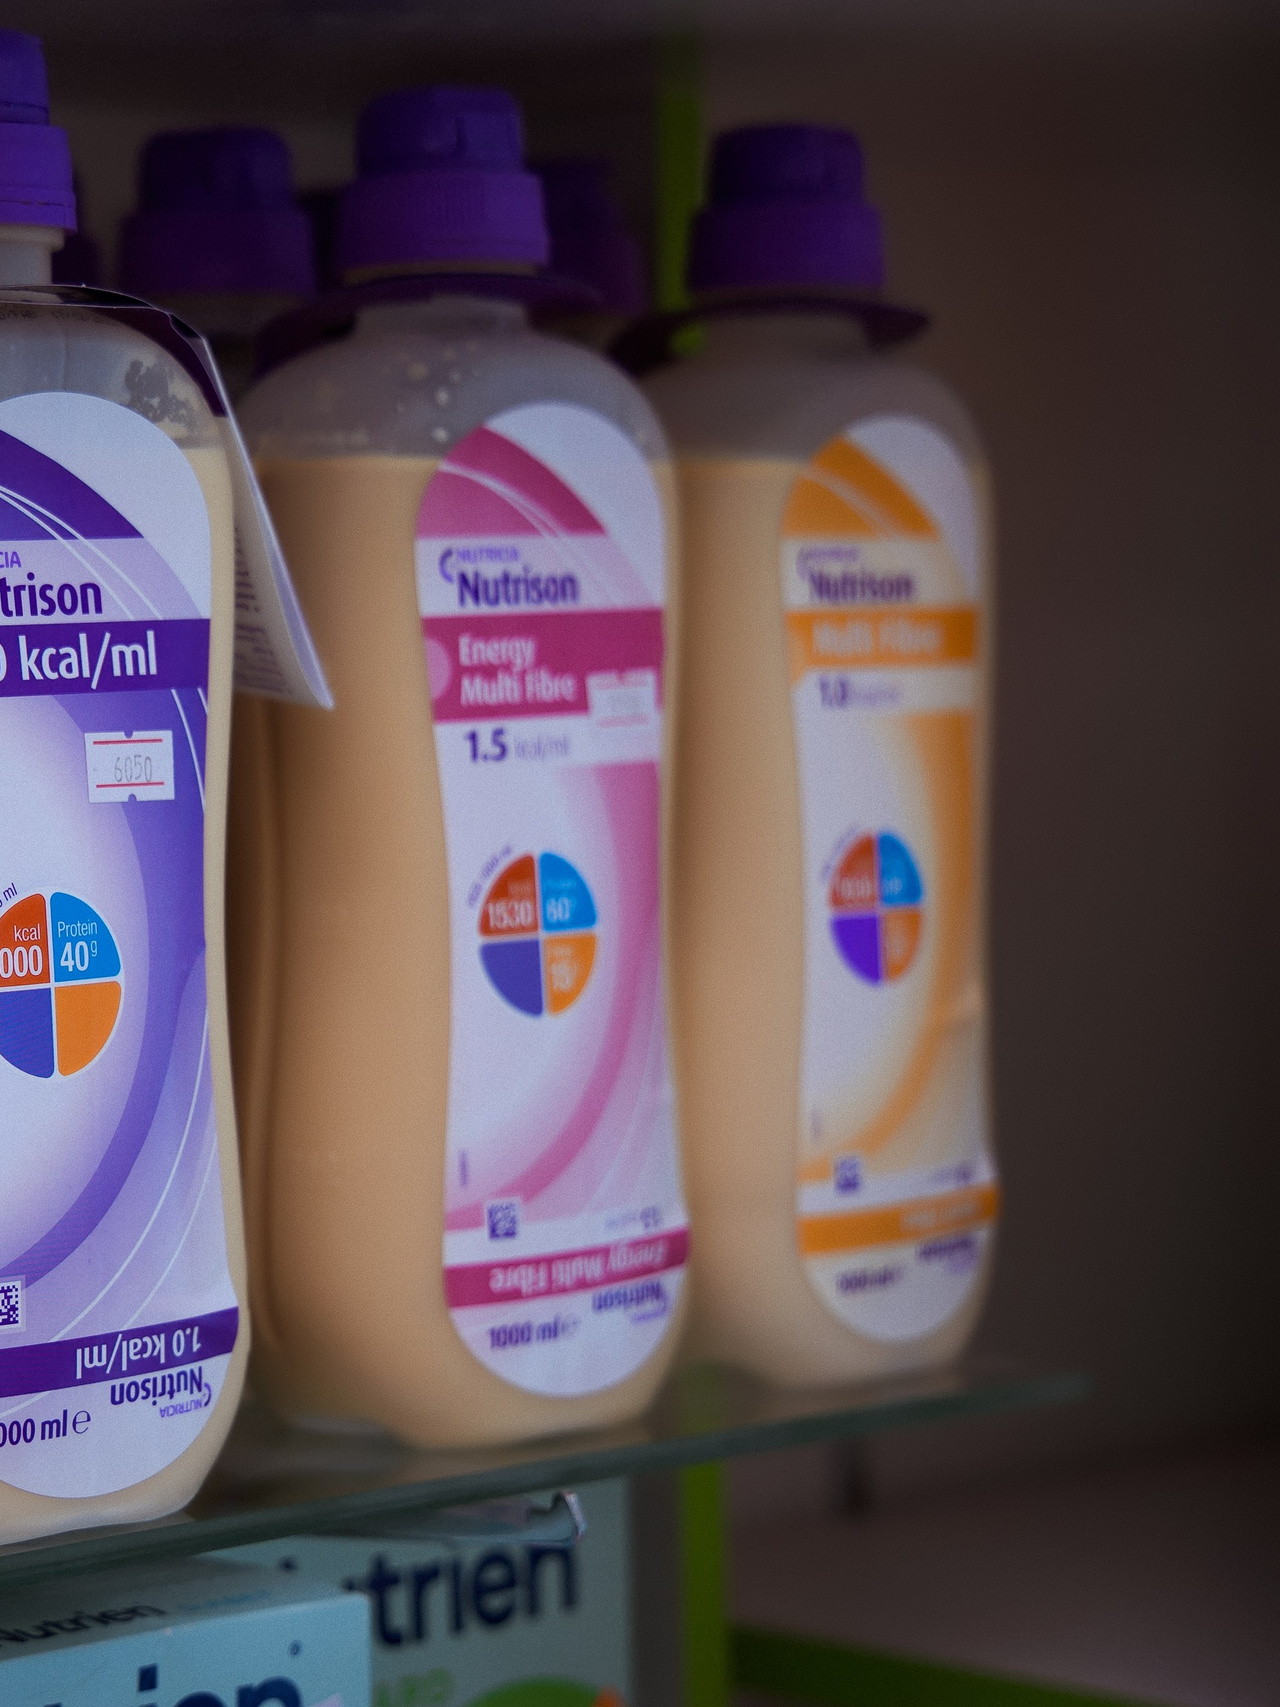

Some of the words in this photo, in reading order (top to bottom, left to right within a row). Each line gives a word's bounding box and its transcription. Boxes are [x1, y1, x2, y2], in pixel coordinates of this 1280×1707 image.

[457, 567, 580, 607] Nutrison
[18, 628, 158, 690] kcal/ml
[458, 634, 536, 672] Energy
[460, 669, 521, 706] Multi
[524, 666, 577, 703] Fibre
[464, 727, 509, 763] 1.5
[114, 754, 153, 783] 6050
[3, 882, 18, 902] ml
[14, 923, 41, 942] kcal
[57, 919, 98, 938] Protein
[172, 1326, 201, 1356] 1.0
[489, 1321, 533, 1349] 1000
[75, 1332, 166, 1380] kcal/ml
[110, 1366, 203, 1406] Nutrison
[40, 1409, 68, 1441] ml
